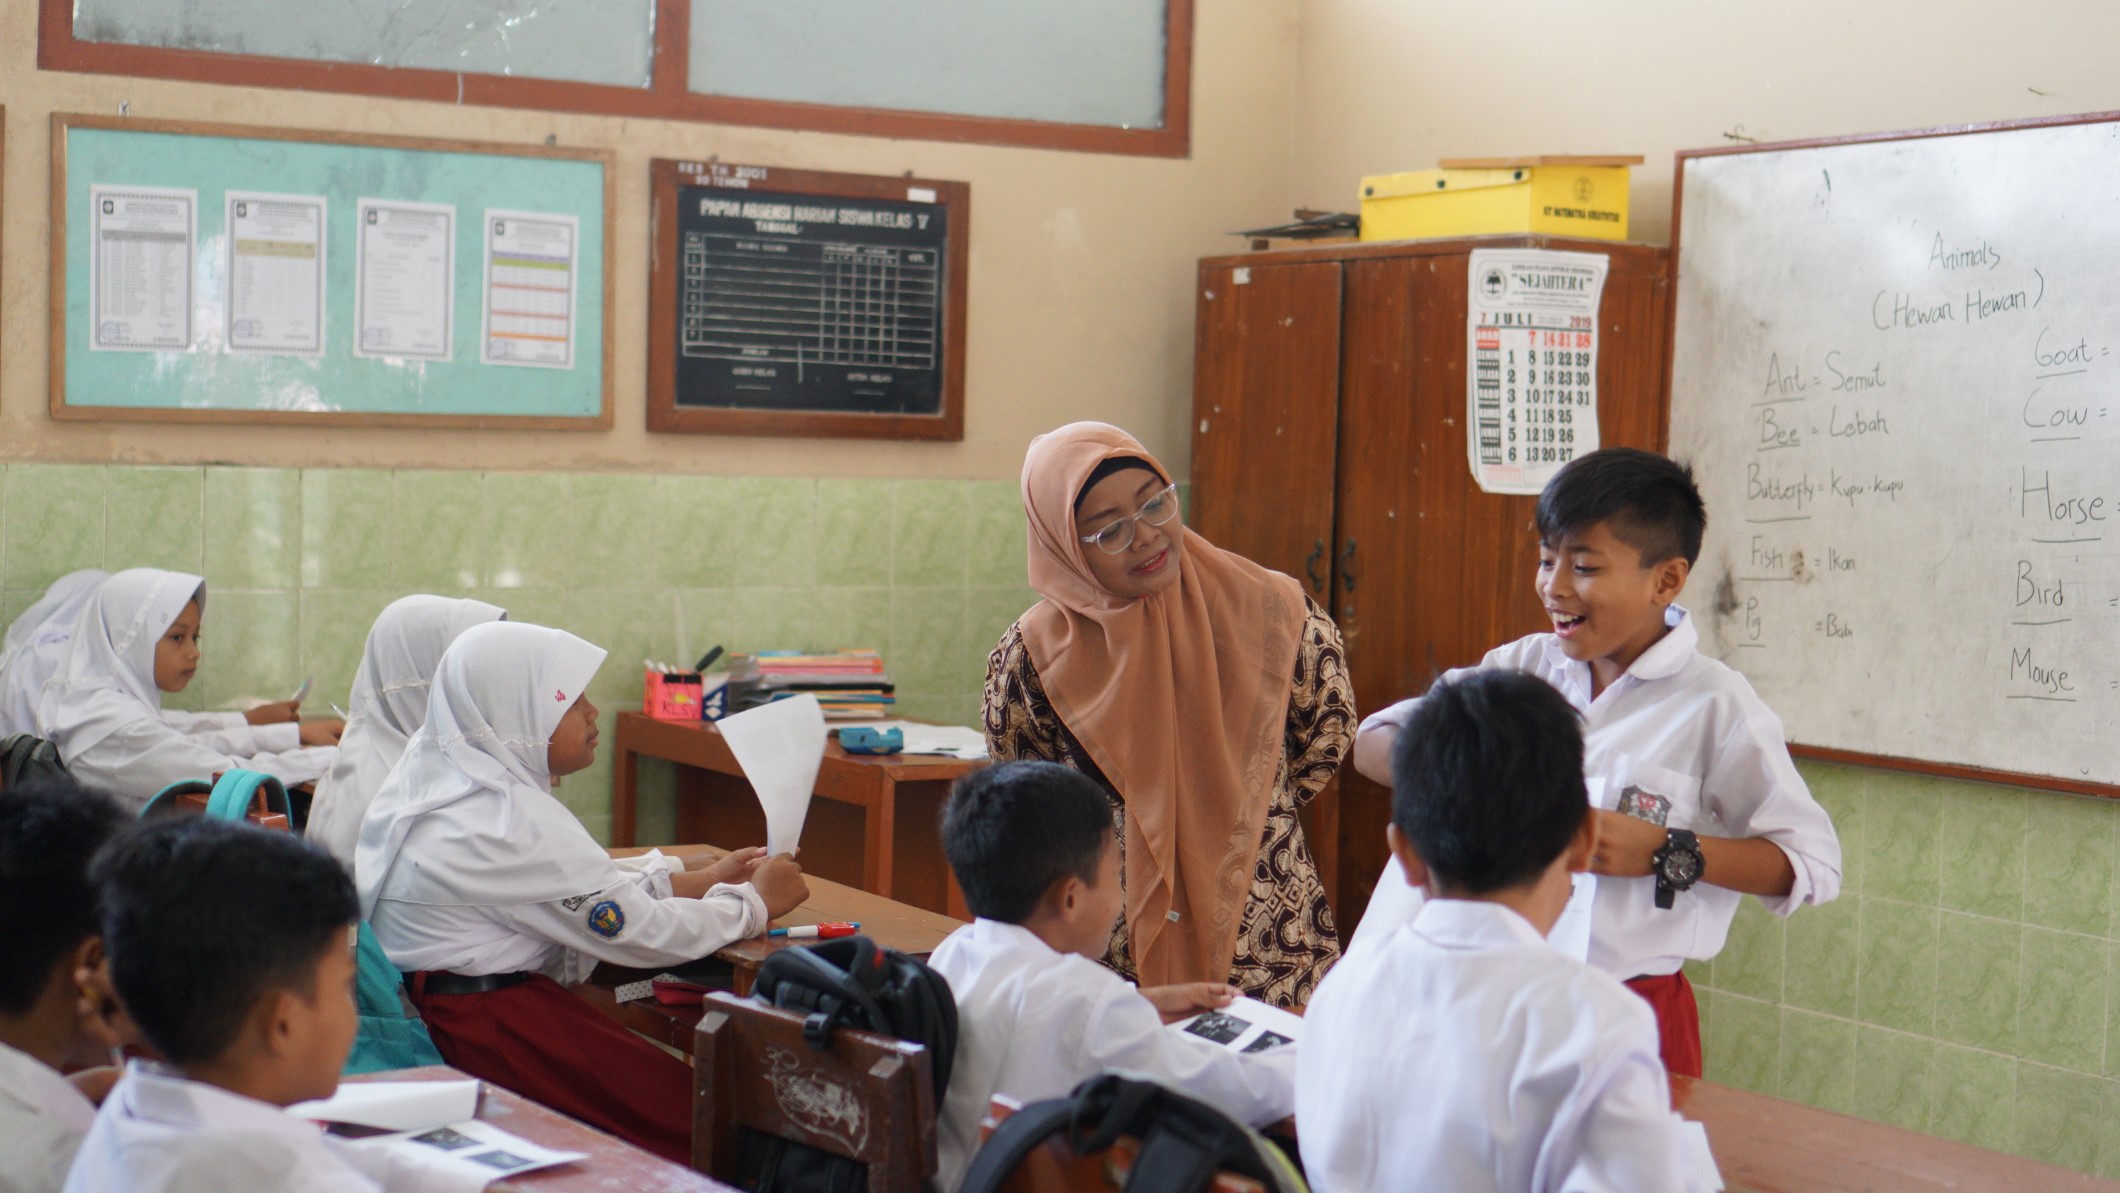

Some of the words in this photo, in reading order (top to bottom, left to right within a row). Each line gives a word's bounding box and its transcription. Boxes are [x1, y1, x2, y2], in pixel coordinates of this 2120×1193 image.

[735, 166, 768, 180] 2001
[700, 198, 741, 218] PAPAN
[741, 202, 792, 221] ABSENSI
[793, 205, 837, 223] HARIAN
[838, 208, 874, 226] SISWA
[875, 211, 914, 229] KELAS
[1928, 230, 2000, 270] Animals
[1873, 289, 1954, 331] (Hewan
[1965, 268, 2044, 324] Hewan)
[1495, 312, 1532, 325] JULI
[1508, 350, 1515, 364] 1
[1528, 351, 1536, 365] 8
[1543, 351, 1554, 365] 15
[1558, 352, 1572, 366] 22
[1576, 352, 1590, 366] 29
[1528, 331, 1536, 345] 7
[1543, 332, 1554, 346] 14
[1558, 333, 1571, 347] 21
[1575, 334, 1591, 348] 28
[2034, 326, 2093, 367] Goat
[1507, 370, 1516, 384] 2
[1528, 370, 1536, 384] 9
[1543, 370, 1554, 384] 16
[1558, 371, 1572, 385] 23
[1576, 372, 1590, 386] 30
[1763, 351, 1806, 396] Ant
[1825, 350, 1886, 392] Semut
[1507, 389, 1516, 403] 3
[1526, 389, 1540, 403] 10
[1542, 390, 1554, 404] 17
[1558, 390, 1572, 404] 24
[1576, 391, 1590, 406] 31
[2023, 387, 2088, 428] Cow
[1507, 409, 1516, 423] 4
[1526, 409, 1538, 423] 11
[1542, 409, 1554, 423] 18
[1558, 410, 1572, 424] 25
[1508, 428, 1516, 442] 5
[1526, 428, 1539, 442] 12
[1542, 428, 1554, 442] 19
[1559, 428, 1574, 442] 26
[1760, 408, 1799, 445] Bee
[1829, 405, 1889, 438] Lebah
[1508, 447, 1516, 461] 6
[1526, 447, 1538, 461] 13
[1542, 448, 1556, 462] 20
[1558, 448, 1573, 462] 27
[1747, 463, 1814, 510] Butterfly
[2021, 465, 2106, 524] Horse
[1751, 535, 1784, 569] Fish
[2016, 560, 2064, 607] Bird
[1746, 597, 1761, 641] Pig
[2010, 647, 2075, 694] Mouse
